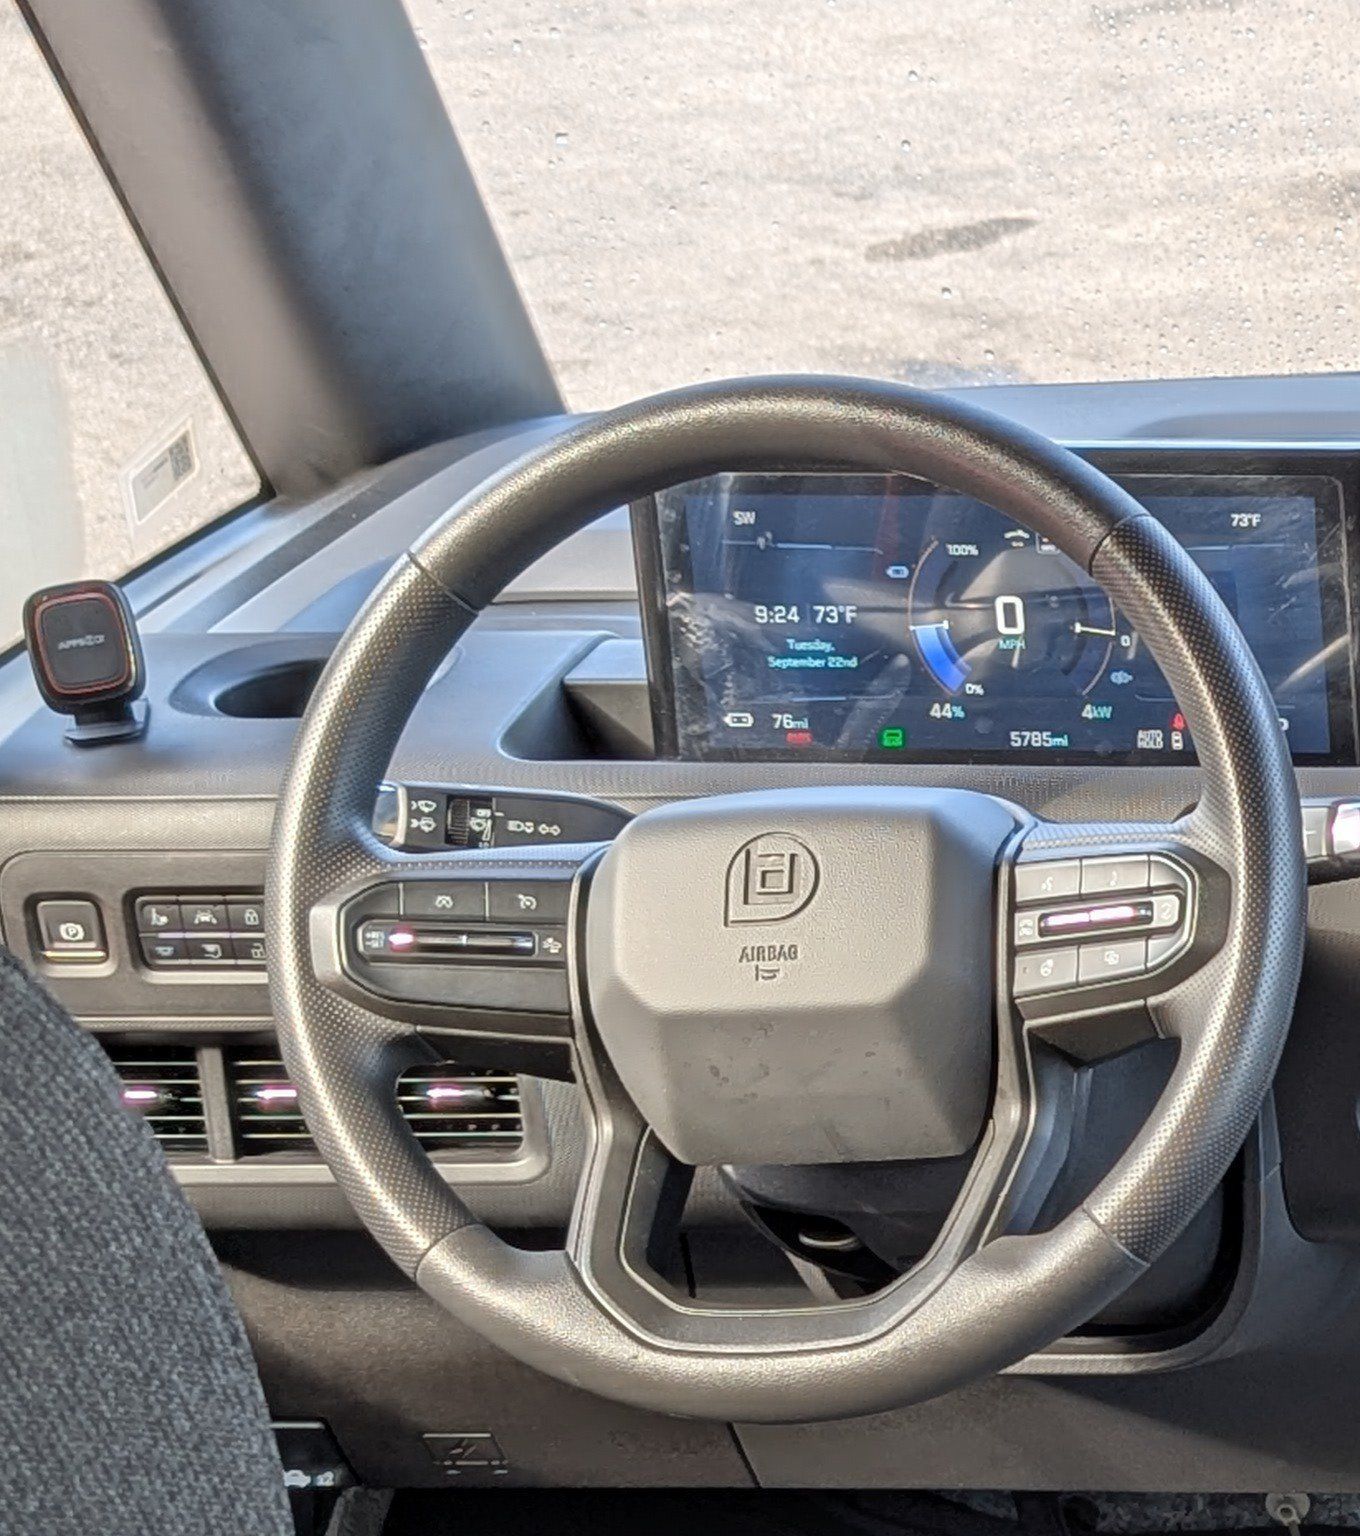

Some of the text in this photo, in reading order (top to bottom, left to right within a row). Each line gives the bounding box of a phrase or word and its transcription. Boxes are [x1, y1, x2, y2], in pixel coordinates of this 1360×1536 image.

[732, 510, 757, 525] SW
[1230, 513, 1262, 527] 73°F
[945, 543, 979, 556] 100%
[755, 605, 859, 624] 9:24 73°F
[994, 595, 1026, 635] 0
[786, 639, 835, 653] Tuesday,
[999, 639, 1026, 650] MPH
[767, 656, 858, 669] September 22nd
[965, 684, 984, 696] 0%
[929, 702, 966, 719] 44%
[1081, 704, 1113, 720] 4kW
[771, 713, 810, 730] 76mi
[1009, 731, 1069, 747] 5785mi
[739, 944, 799, 963] AIRBAG
